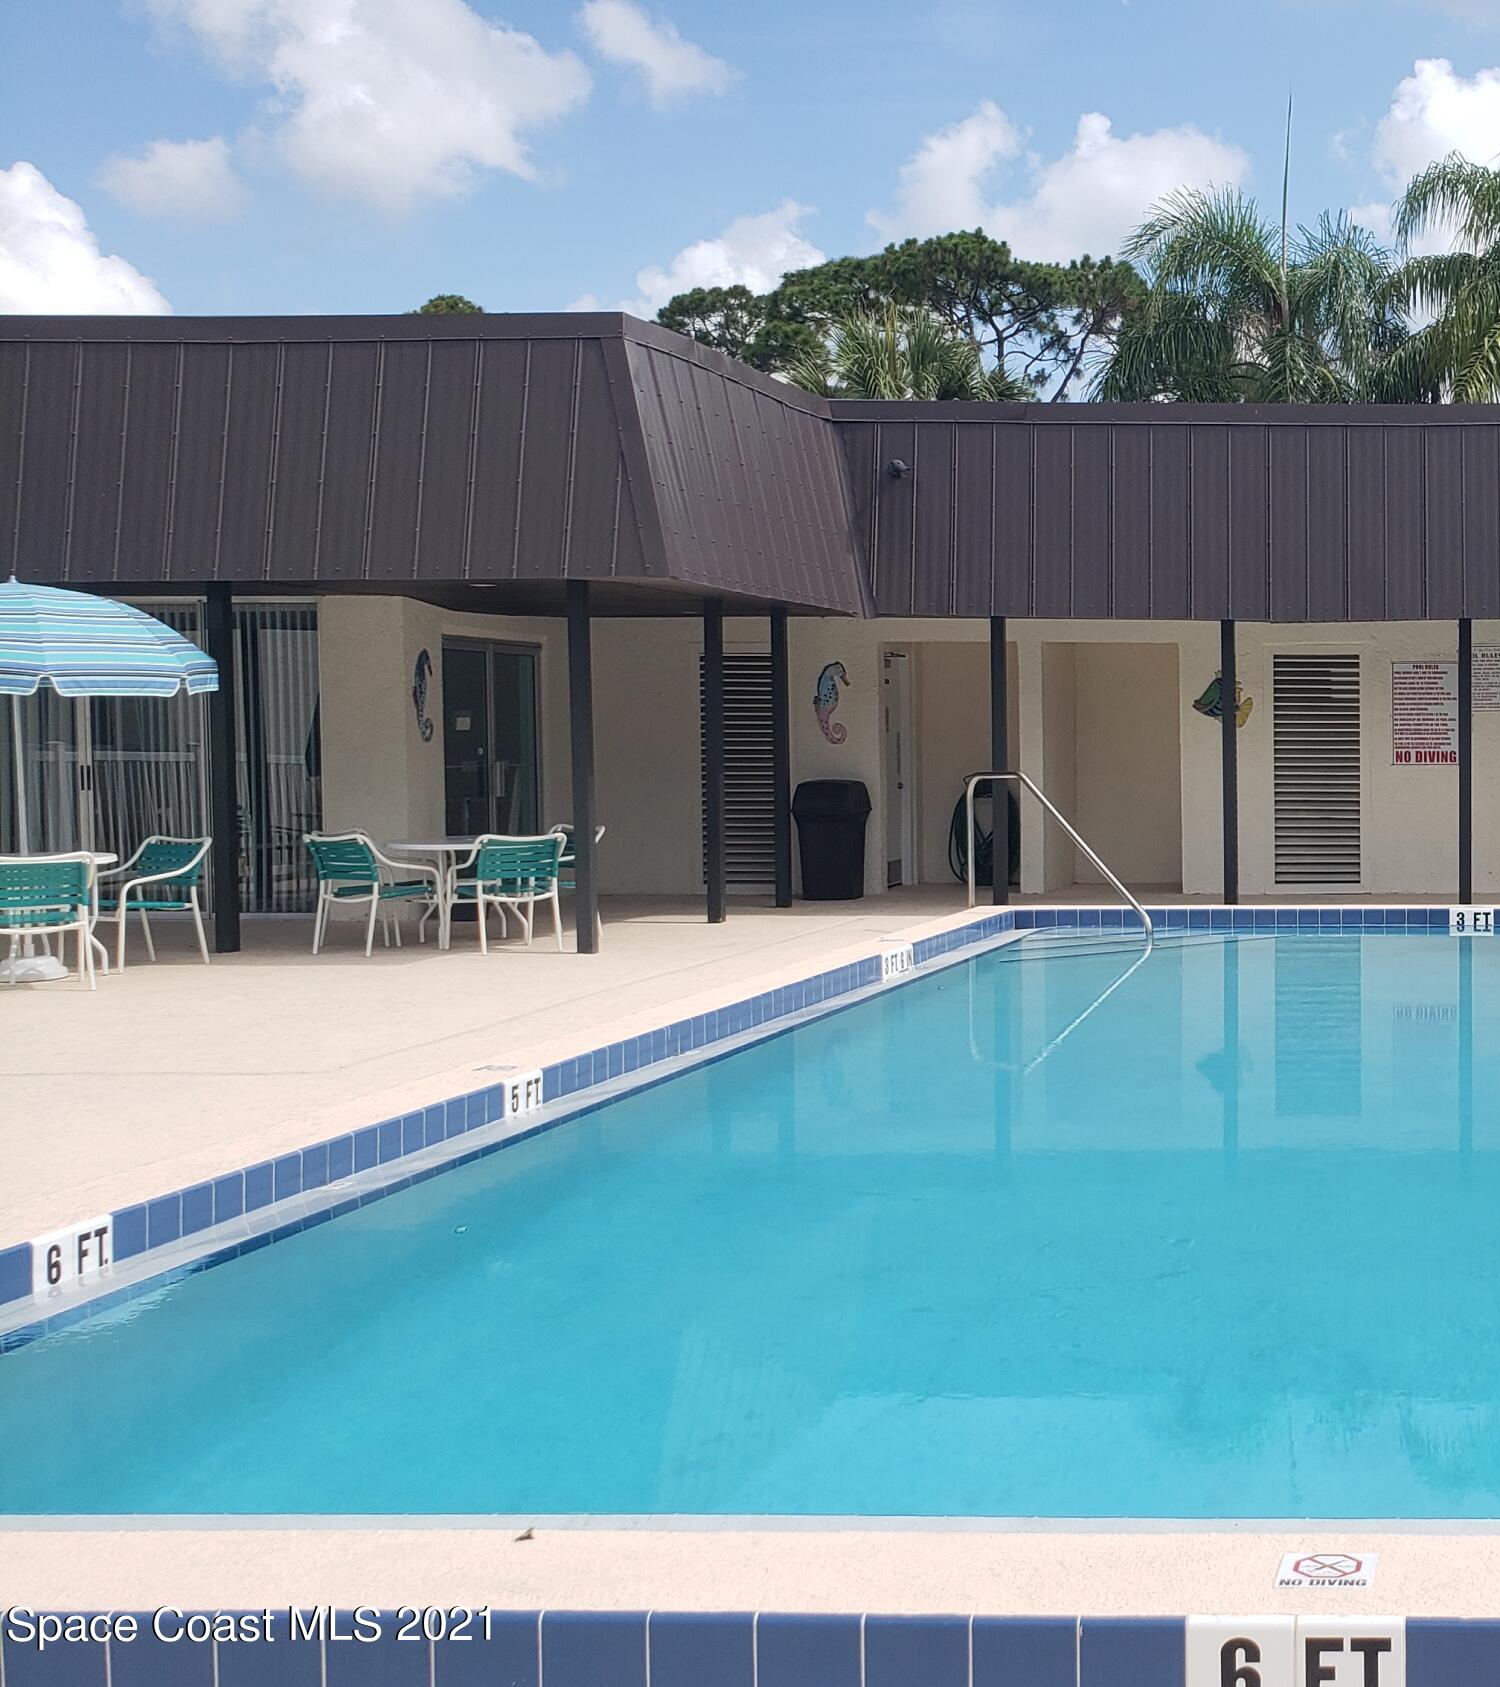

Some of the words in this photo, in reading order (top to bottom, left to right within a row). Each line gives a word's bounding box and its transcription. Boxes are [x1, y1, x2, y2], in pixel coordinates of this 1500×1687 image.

[1395, 750, 1411, 763] NO
[1415, 750, 1457, 763] DIVING
[511, 1083, 519, 1113] 5
[47, 1243, 61, 1285] 6
[1278, 1578, 1303, 1586] NO
[1308, 1578, 1368, 1586] DIVING
[1220, 1637, 1261, 1687] 6
